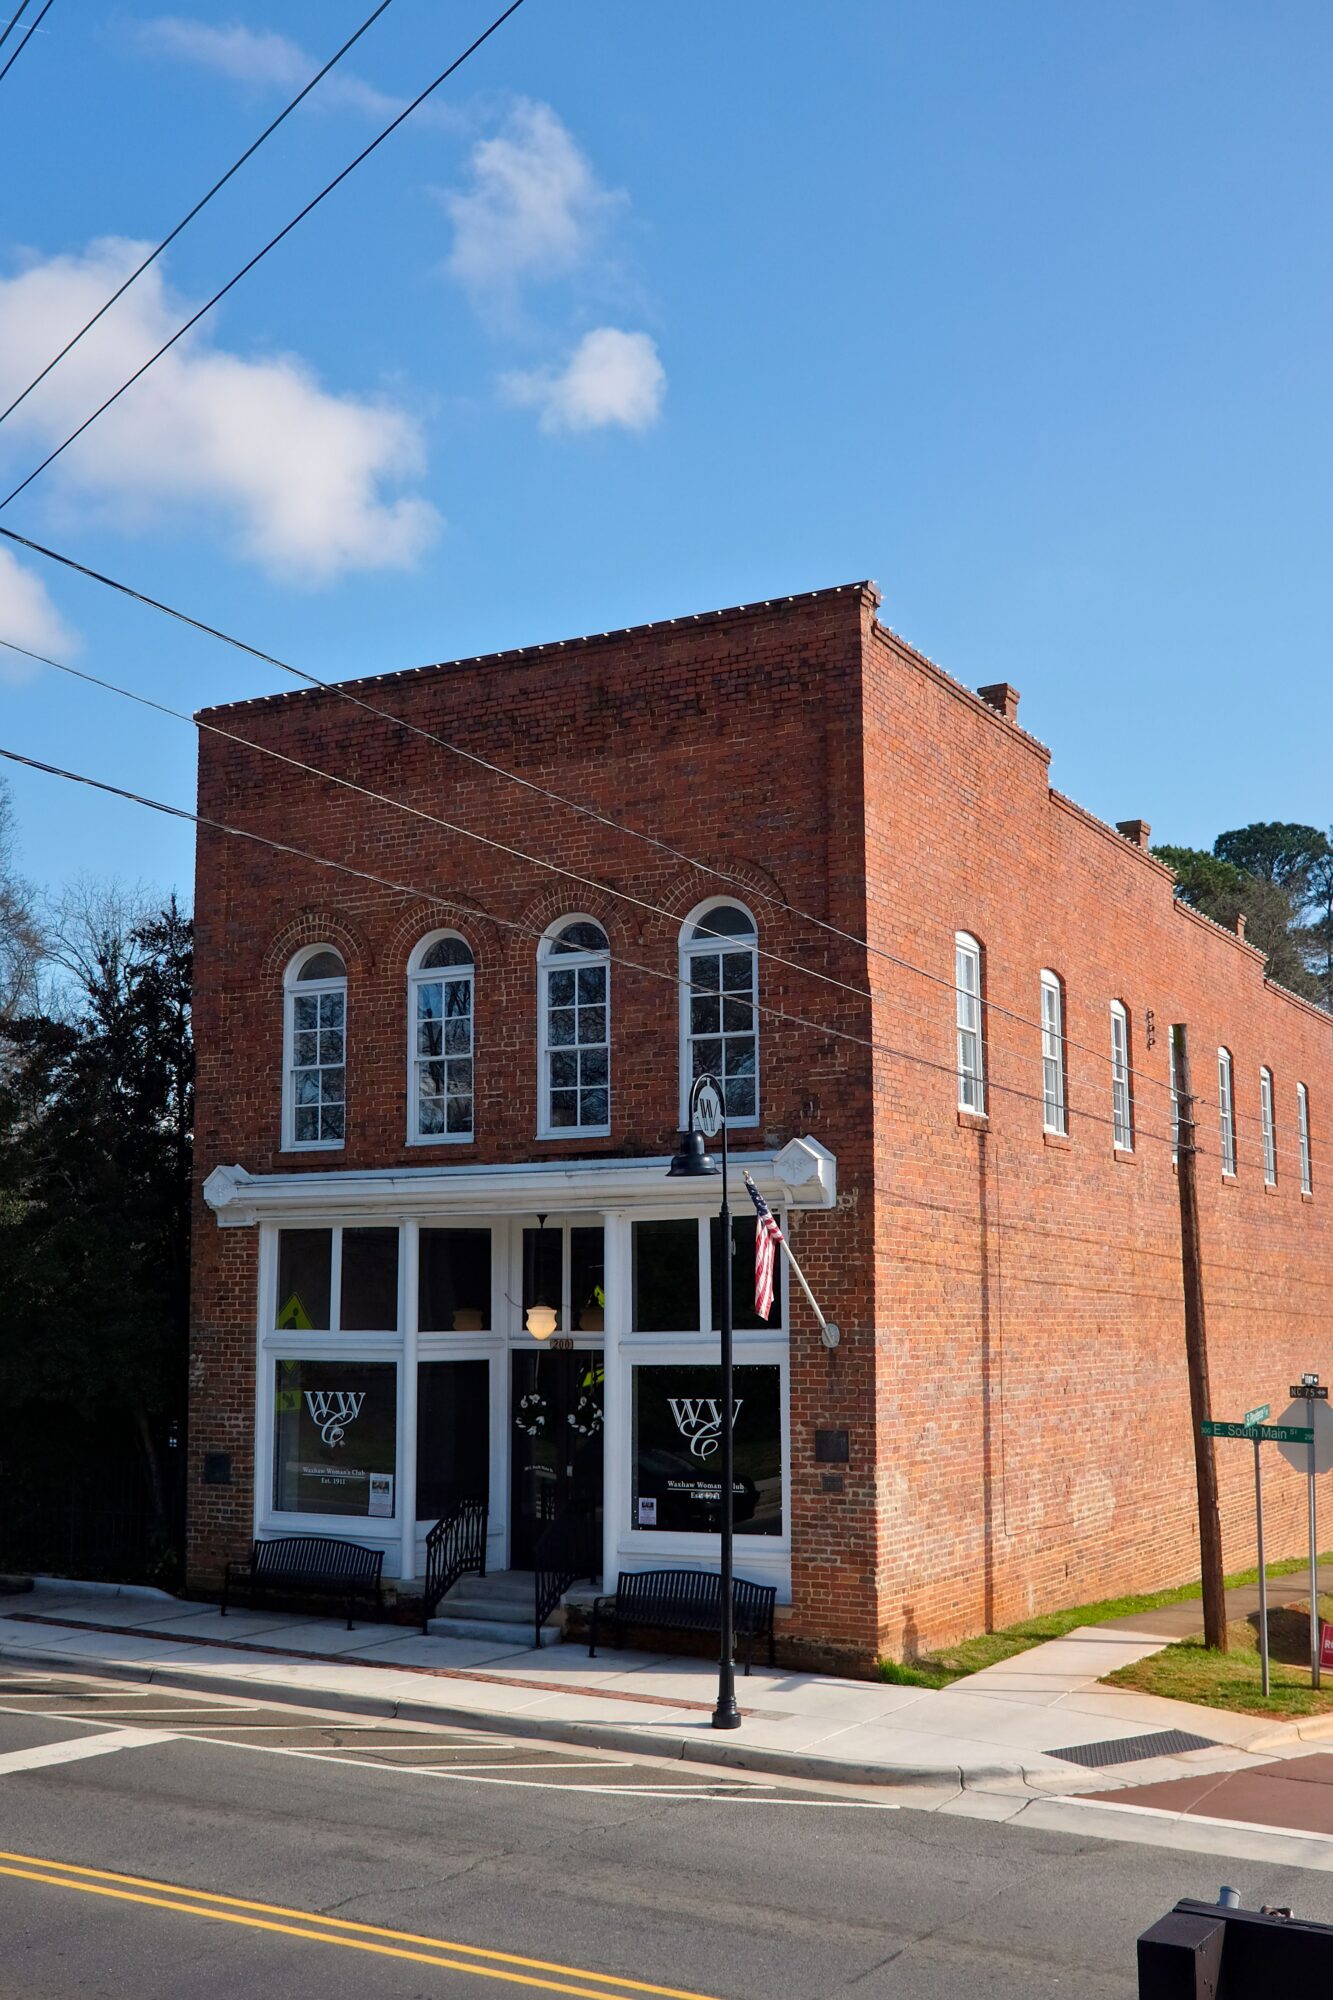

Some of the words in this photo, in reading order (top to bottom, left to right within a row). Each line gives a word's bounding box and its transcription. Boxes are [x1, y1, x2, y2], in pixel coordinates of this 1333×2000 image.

[1291, 1388, 1301, 1397] NC
[1305, 1388, 1315, 1397] 75
[1213, 1424, 1224, 1436] E.
[1227, 1424, 1258, 1438] South
[1261, 1427, 1287, 1440] Main
[327, 1467, 350, 1475] Woman's
[667, 1480, 695, 1488] Waxhaw
[697, 1481, 722, 1489] Woman
[732, 1482, 745, 1491] lub
